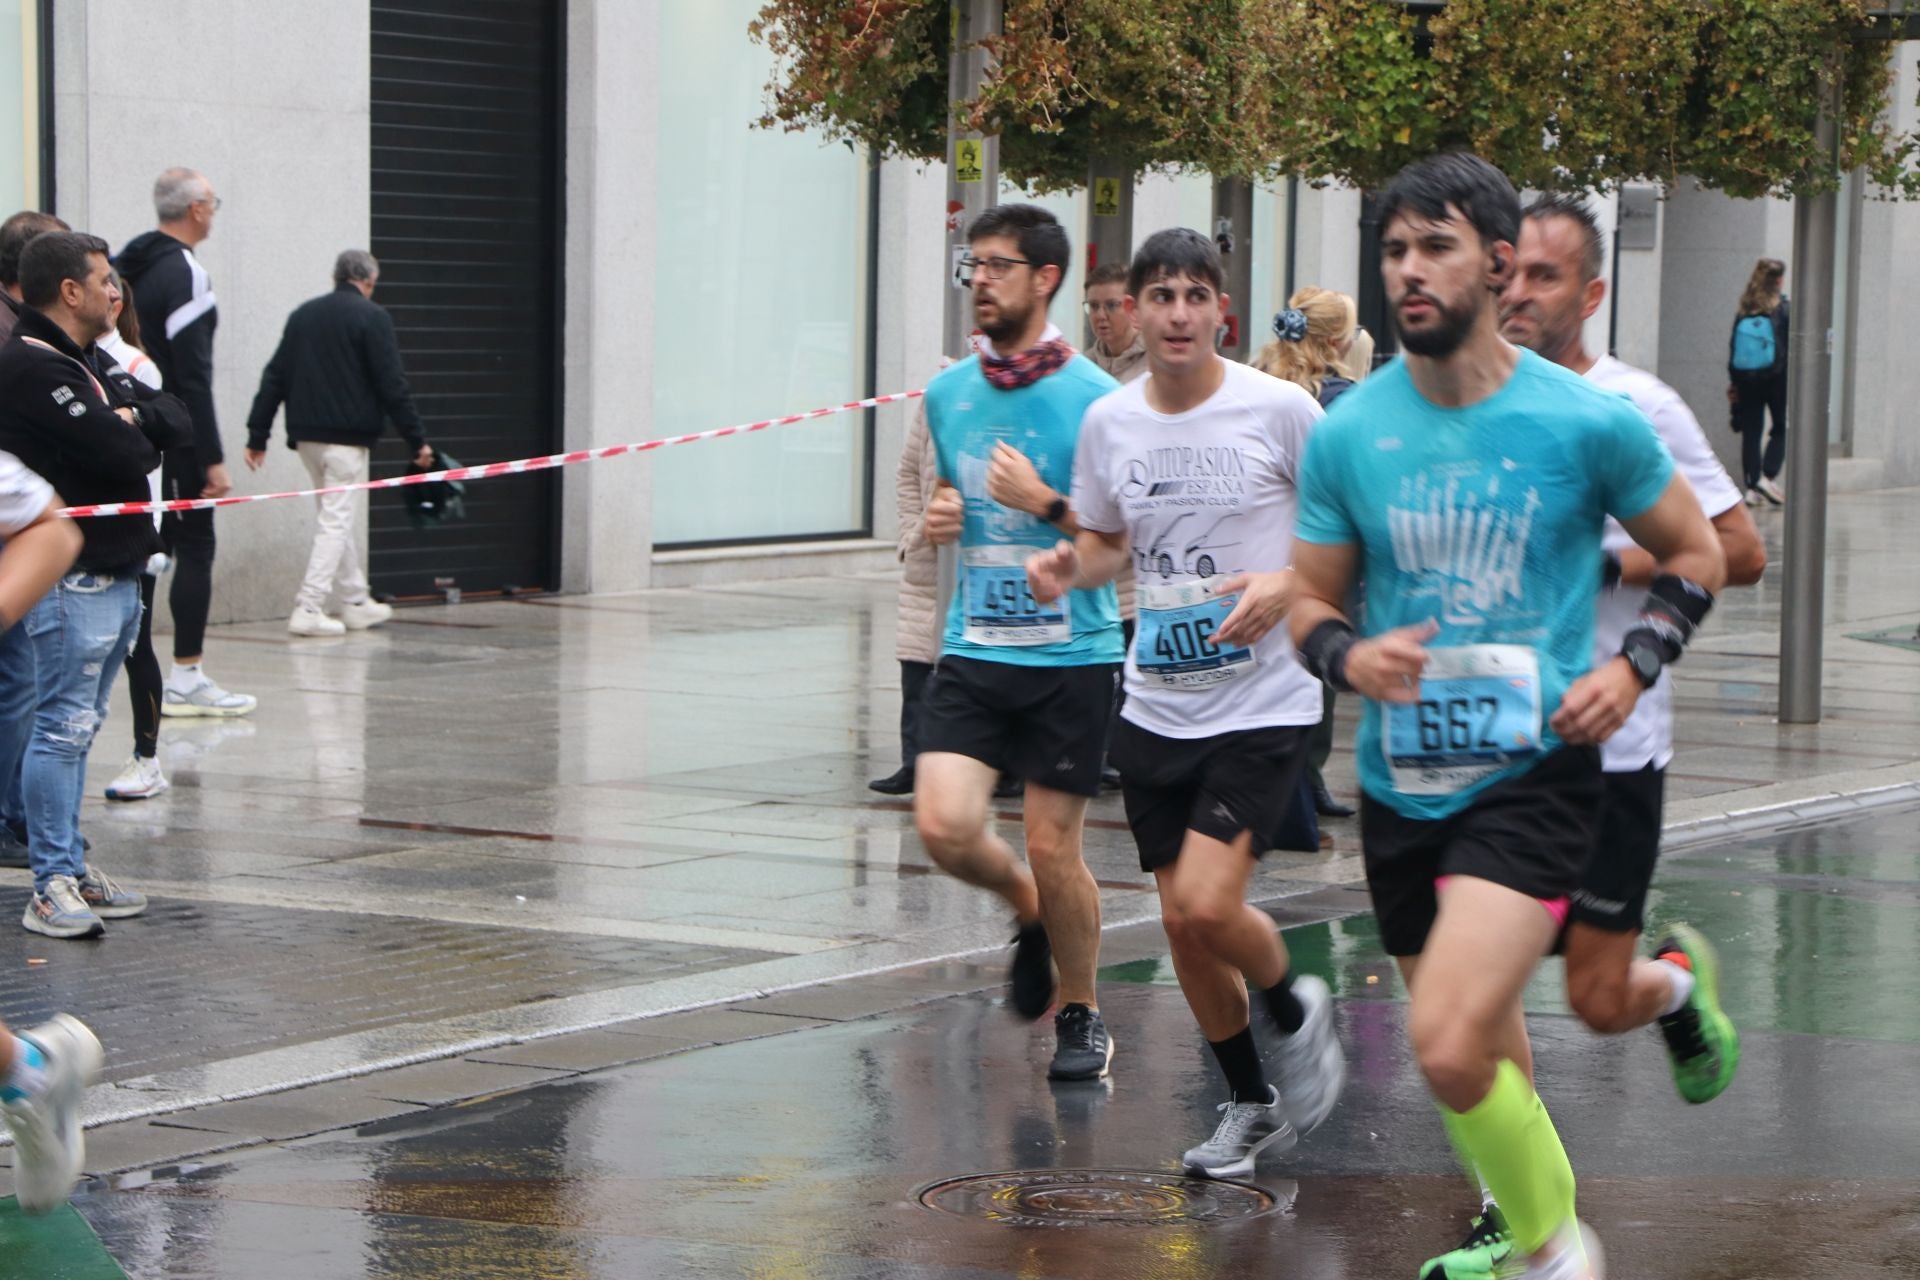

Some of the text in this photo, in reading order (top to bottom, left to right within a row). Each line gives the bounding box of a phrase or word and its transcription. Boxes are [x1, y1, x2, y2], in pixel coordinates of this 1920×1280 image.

[1165, 498, 1204, 506] PASION
[1207, 497, 1240, 506] CLUB
[1187, 479, 1245, 495] ESPAÑA
[1155, 617, 1221, 661] 406
[1418, 697, 1499, 751] 662
